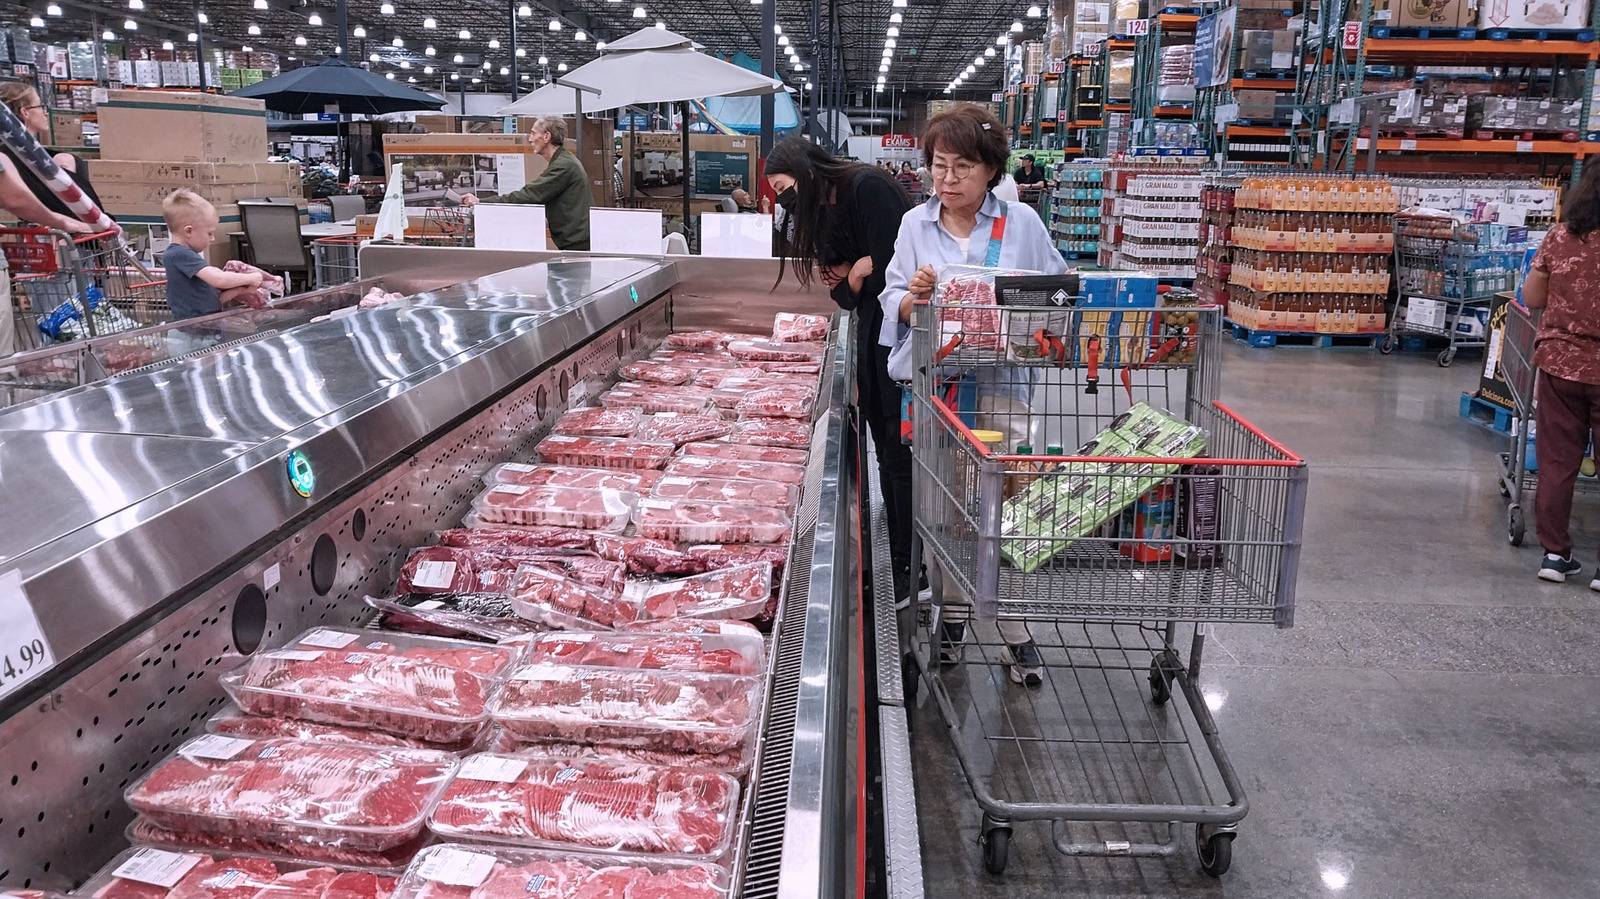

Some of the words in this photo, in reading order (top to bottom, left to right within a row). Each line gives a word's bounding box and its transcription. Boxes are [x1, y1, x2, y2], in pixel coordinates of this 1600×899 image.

[1129, 21, 1147, 34] 124
[1085, 45, 1099, 55] 122
[15, 65, 28, 74] 314
[1052, 62, 1064, 72] 120
[1027, 76, 1038, 85] 118
[0, 638, 45, 686] 4.99
